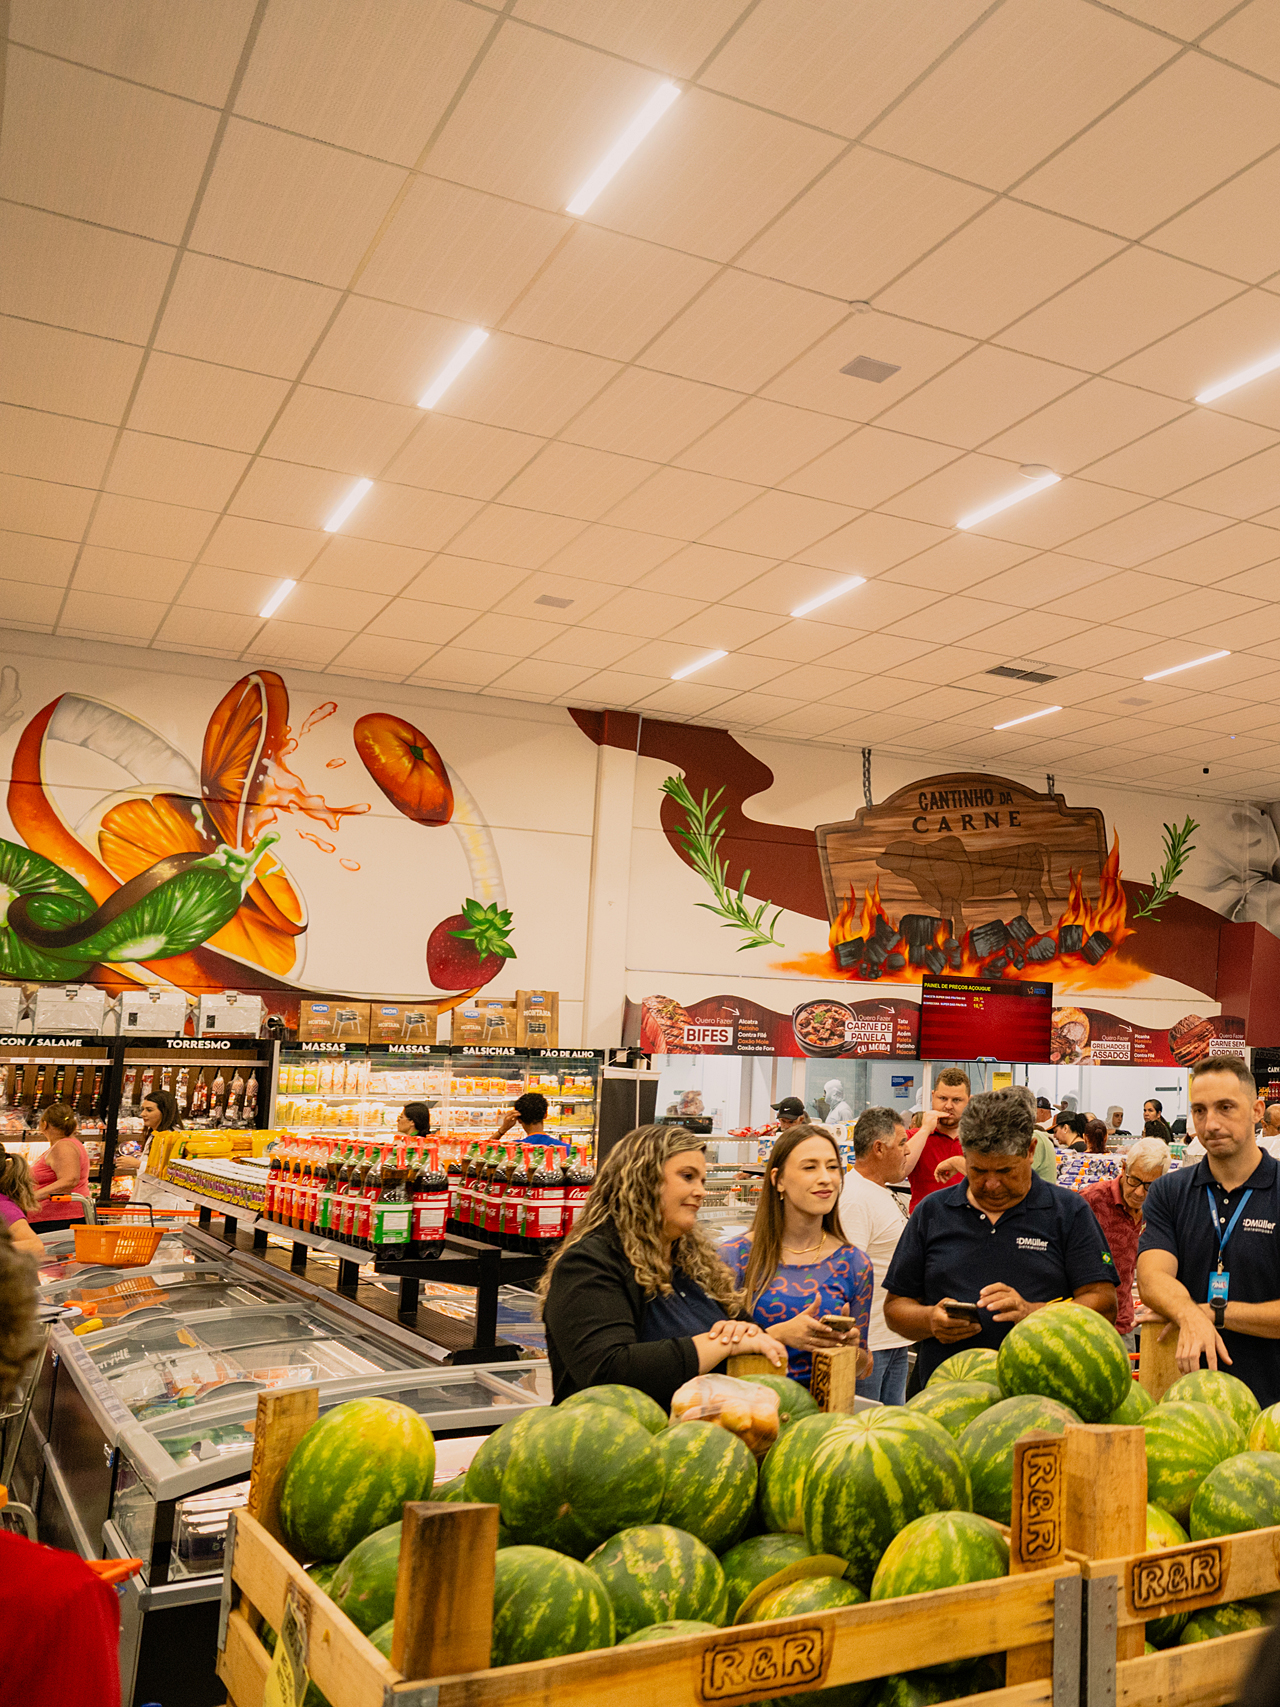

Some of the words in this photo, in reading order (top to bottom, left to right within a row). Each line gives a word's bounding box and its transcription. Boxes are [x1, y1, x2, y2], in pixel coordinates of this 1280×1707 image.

[918, 788, 994, 812] CANTINHO
[998, 791, 1014, 805] DA
[912, 811, 1021, 833] CARNE
[695, 1016, 716, 1024] Quero
[716, 1017, 733, 1025] Fazer
[846, 1021, 879, 1031] CARNE
[880, 1022, 892, 1031] DE
[686, 1028, 729, 1043] BIFES
[850, 1032, 887, 1041] PANELA
[36, 1038, 83, 1047] SALAME
[166, 1039, 231, 1050] TORRESMO
[302, 1041, 346, 1051] MASSAS
[388, 1044, 431, 1054] MASSAS
[462, 1046, 516, 1056] SALSICHAS
[540, 1049, 558, 1057] PÃO
[560, 1050, 570, 1058] DE
[572, 1050, 594, 1058] ALHO
[1092, 1051, 1129, 1059] ASSADOS
[1027, 1451, 1058, 1557] R&R
[1140, 1560, 1221, 1600] R&R
[709, 1637, 818, 1693] R&R
